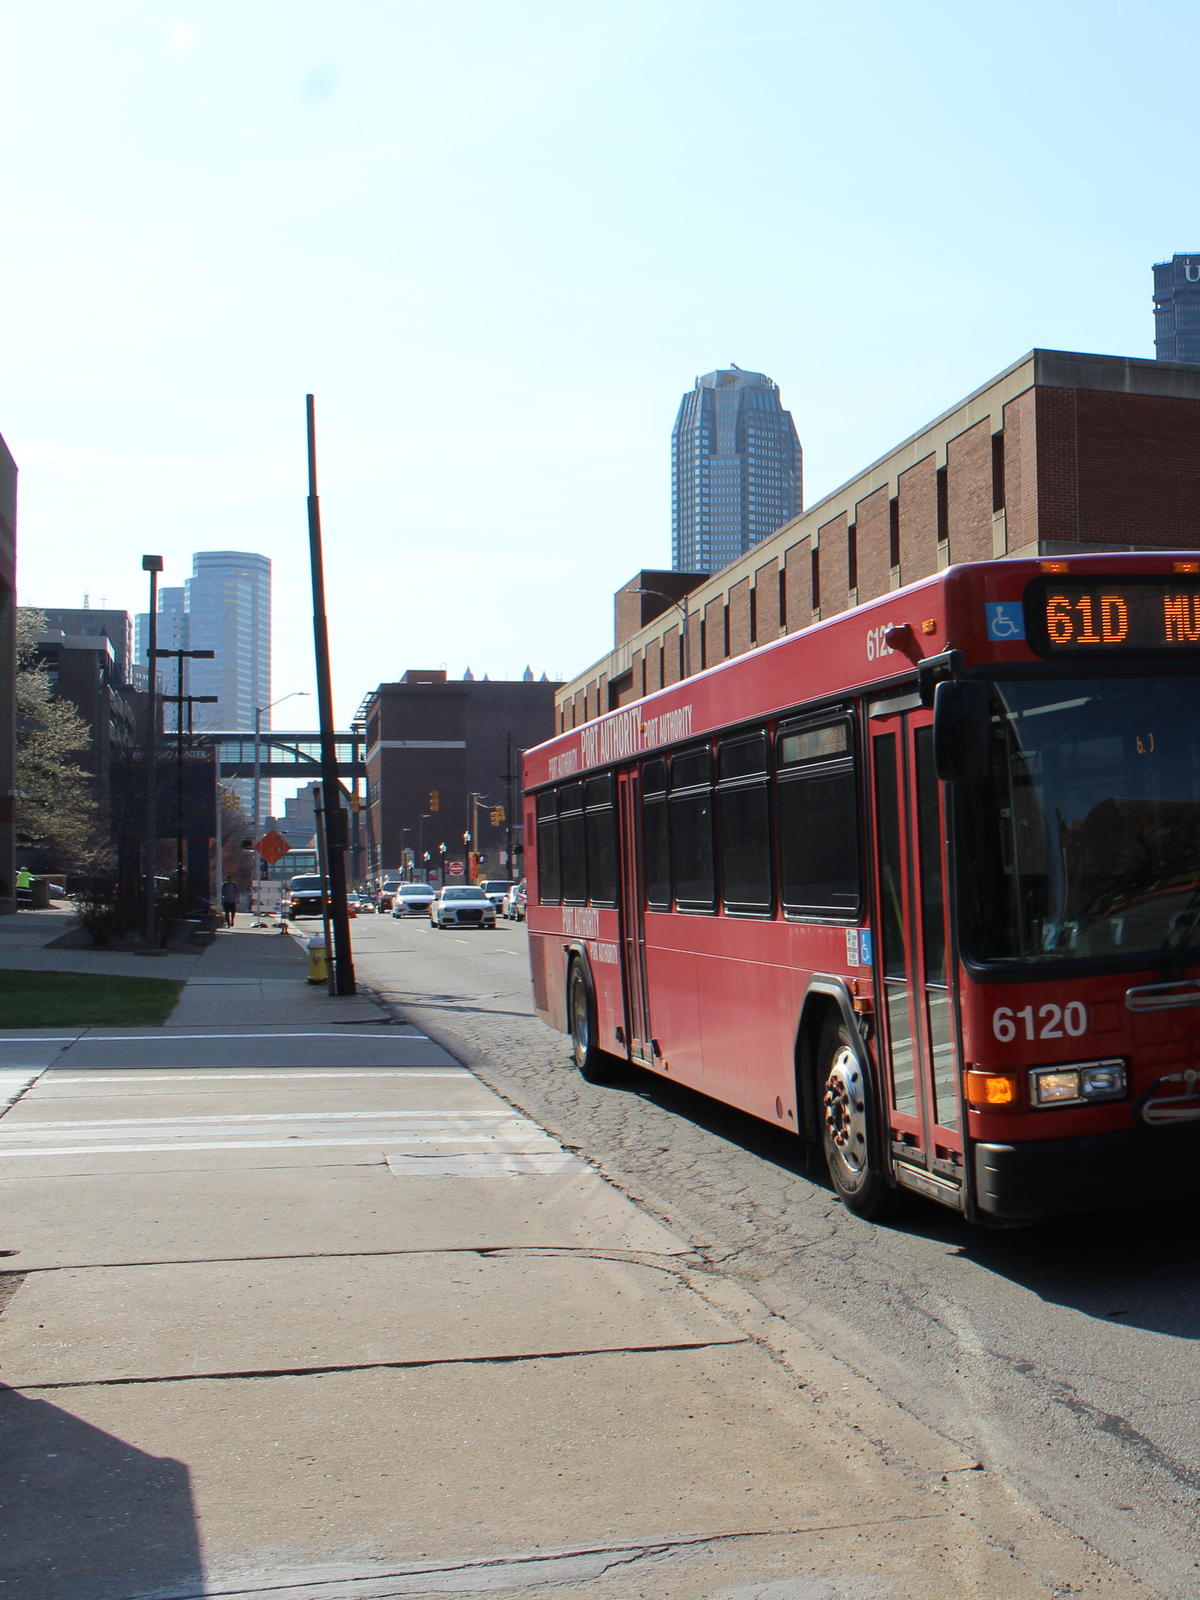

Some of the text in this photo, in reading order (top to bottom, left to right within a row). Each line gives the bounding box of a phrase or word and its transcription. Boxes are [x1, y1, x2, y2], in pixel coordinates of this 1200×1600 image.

[1047, 596, 1128, 643] 61D
[581, 706, 642, 769] PORT AUTHORITY
[644, 704, 693, 748] PORT AUTHORITY
[993, 1001, 1087, 1043] 6120
